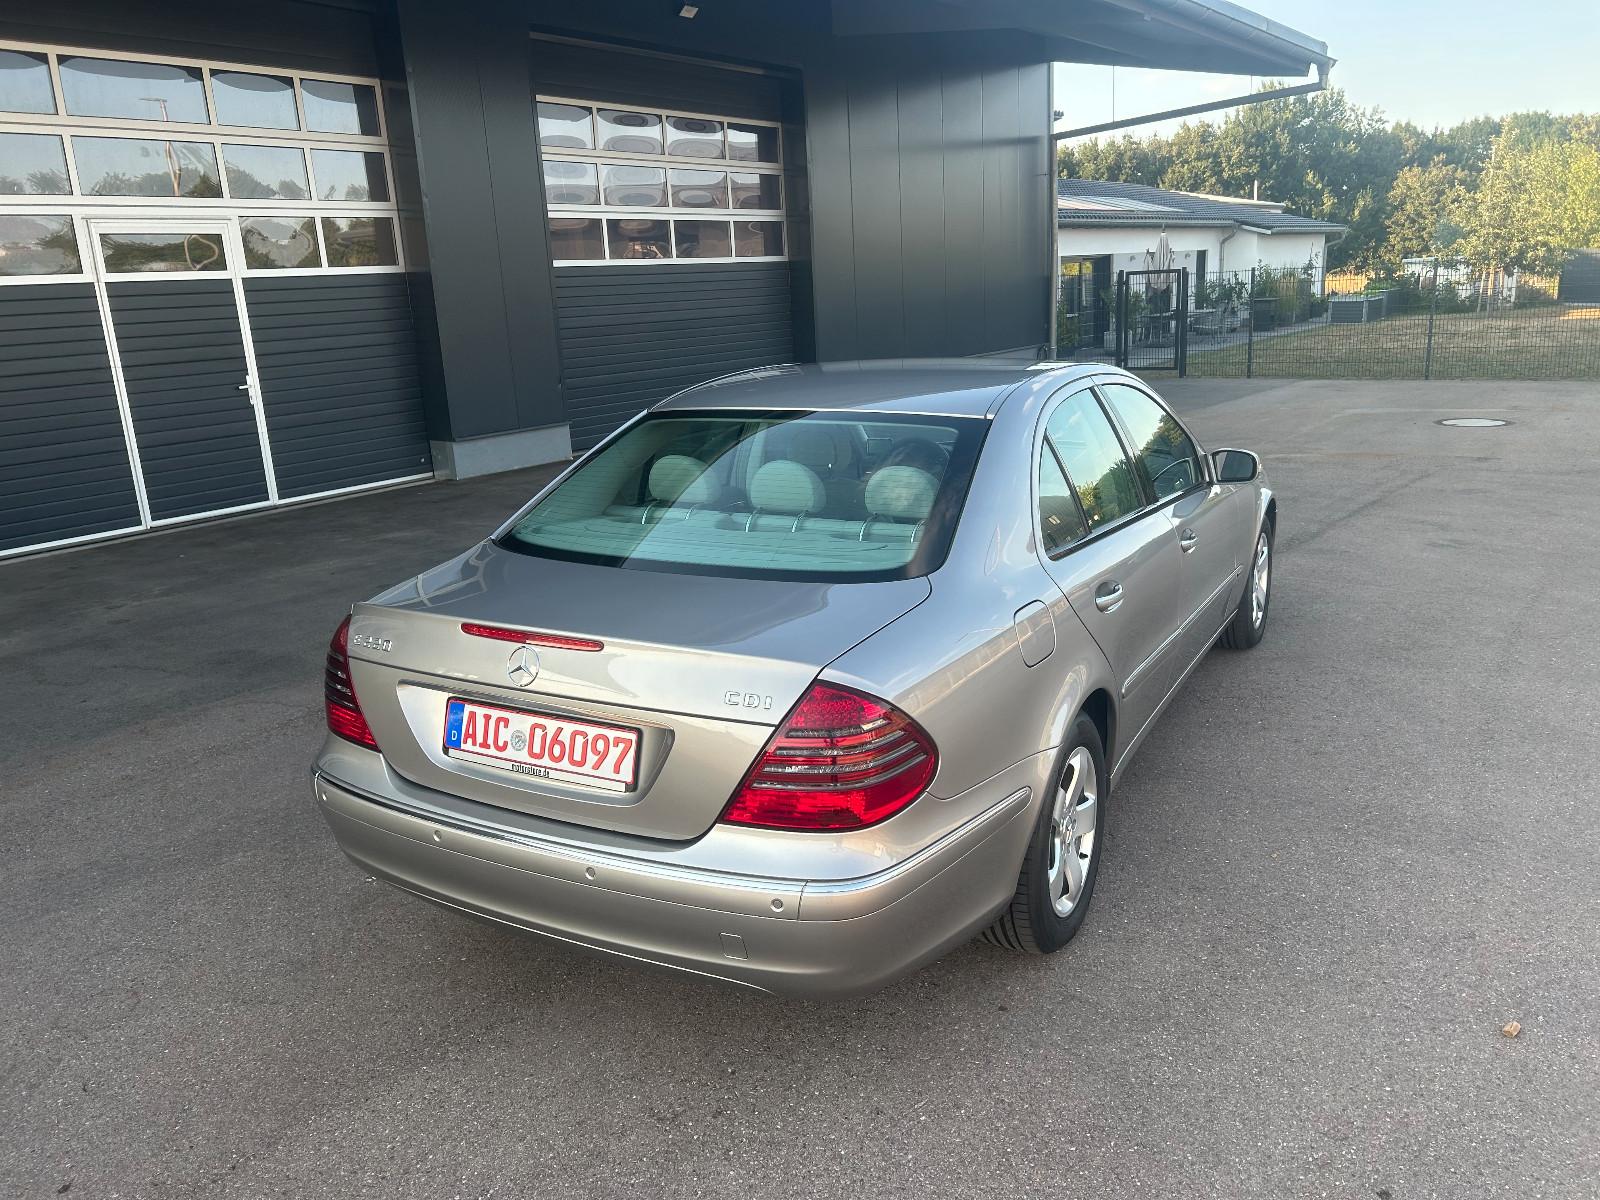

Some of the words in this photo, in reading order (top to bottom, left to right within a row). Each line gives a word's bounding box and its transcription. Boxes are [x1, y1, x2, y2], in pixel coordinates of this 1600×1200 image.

[724, 690, 773, 710] CDI
[451, 730, 458, 741] D
[462, 710, 510, 752] AIC
[527, 723, 633, 775] 06097
